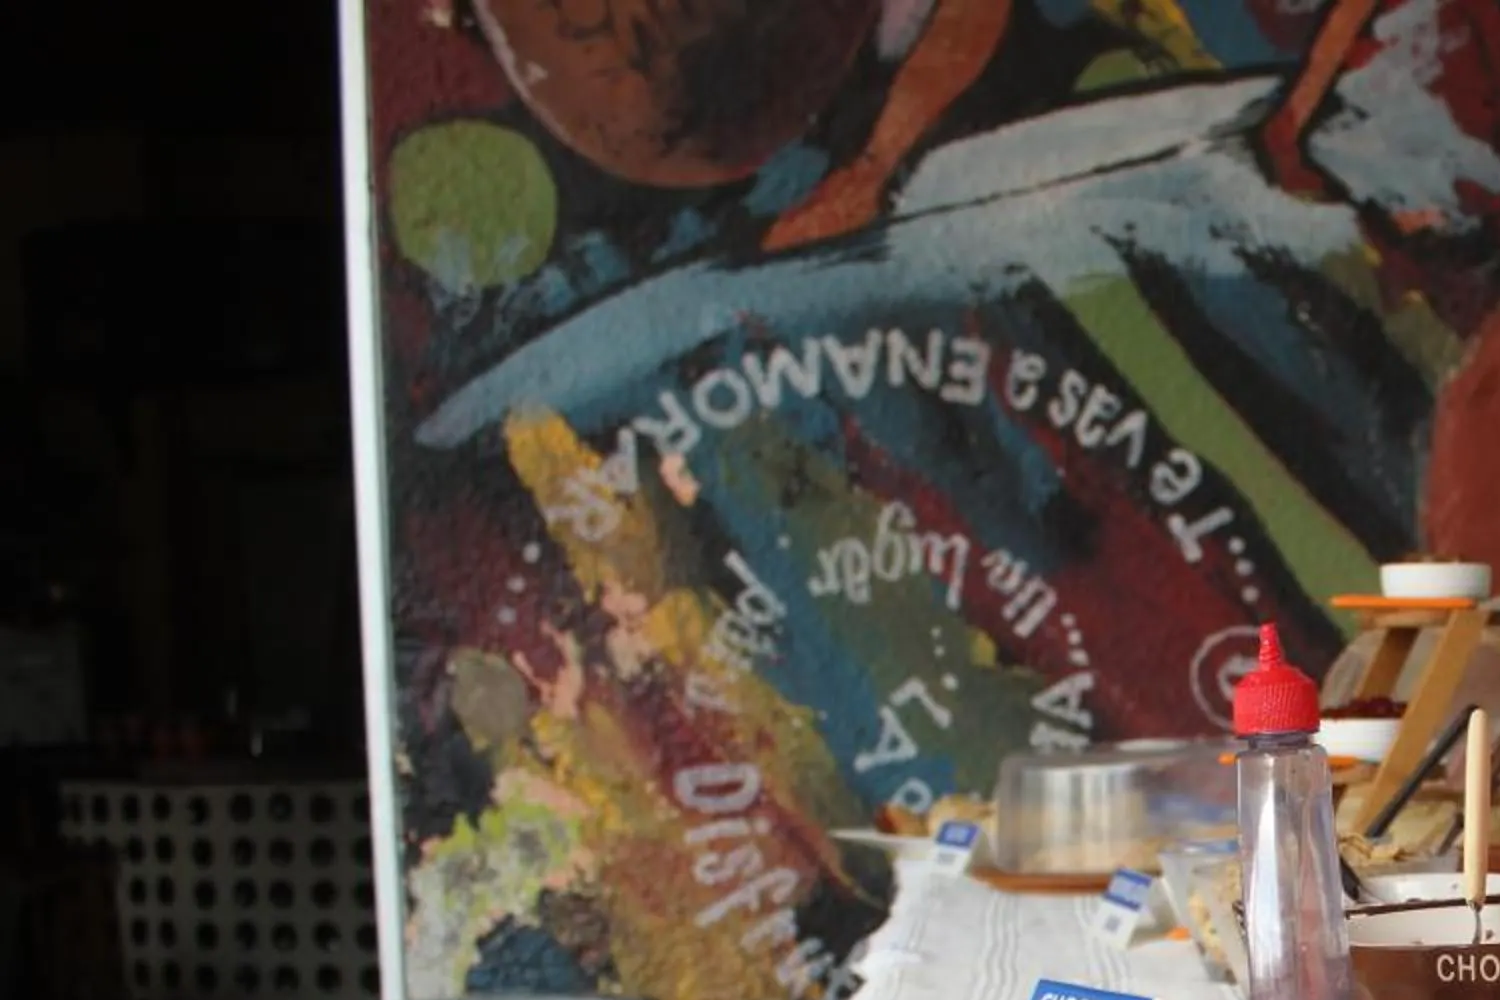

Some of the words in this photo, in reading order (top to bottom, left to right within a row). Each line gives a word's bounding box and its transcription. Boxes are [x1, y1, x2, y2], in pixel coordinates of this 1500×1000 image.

[1006, 349, 1047, 411] a
[1047, 367, 1148, 468] vas
[807, 499, 971, 612] lugar
